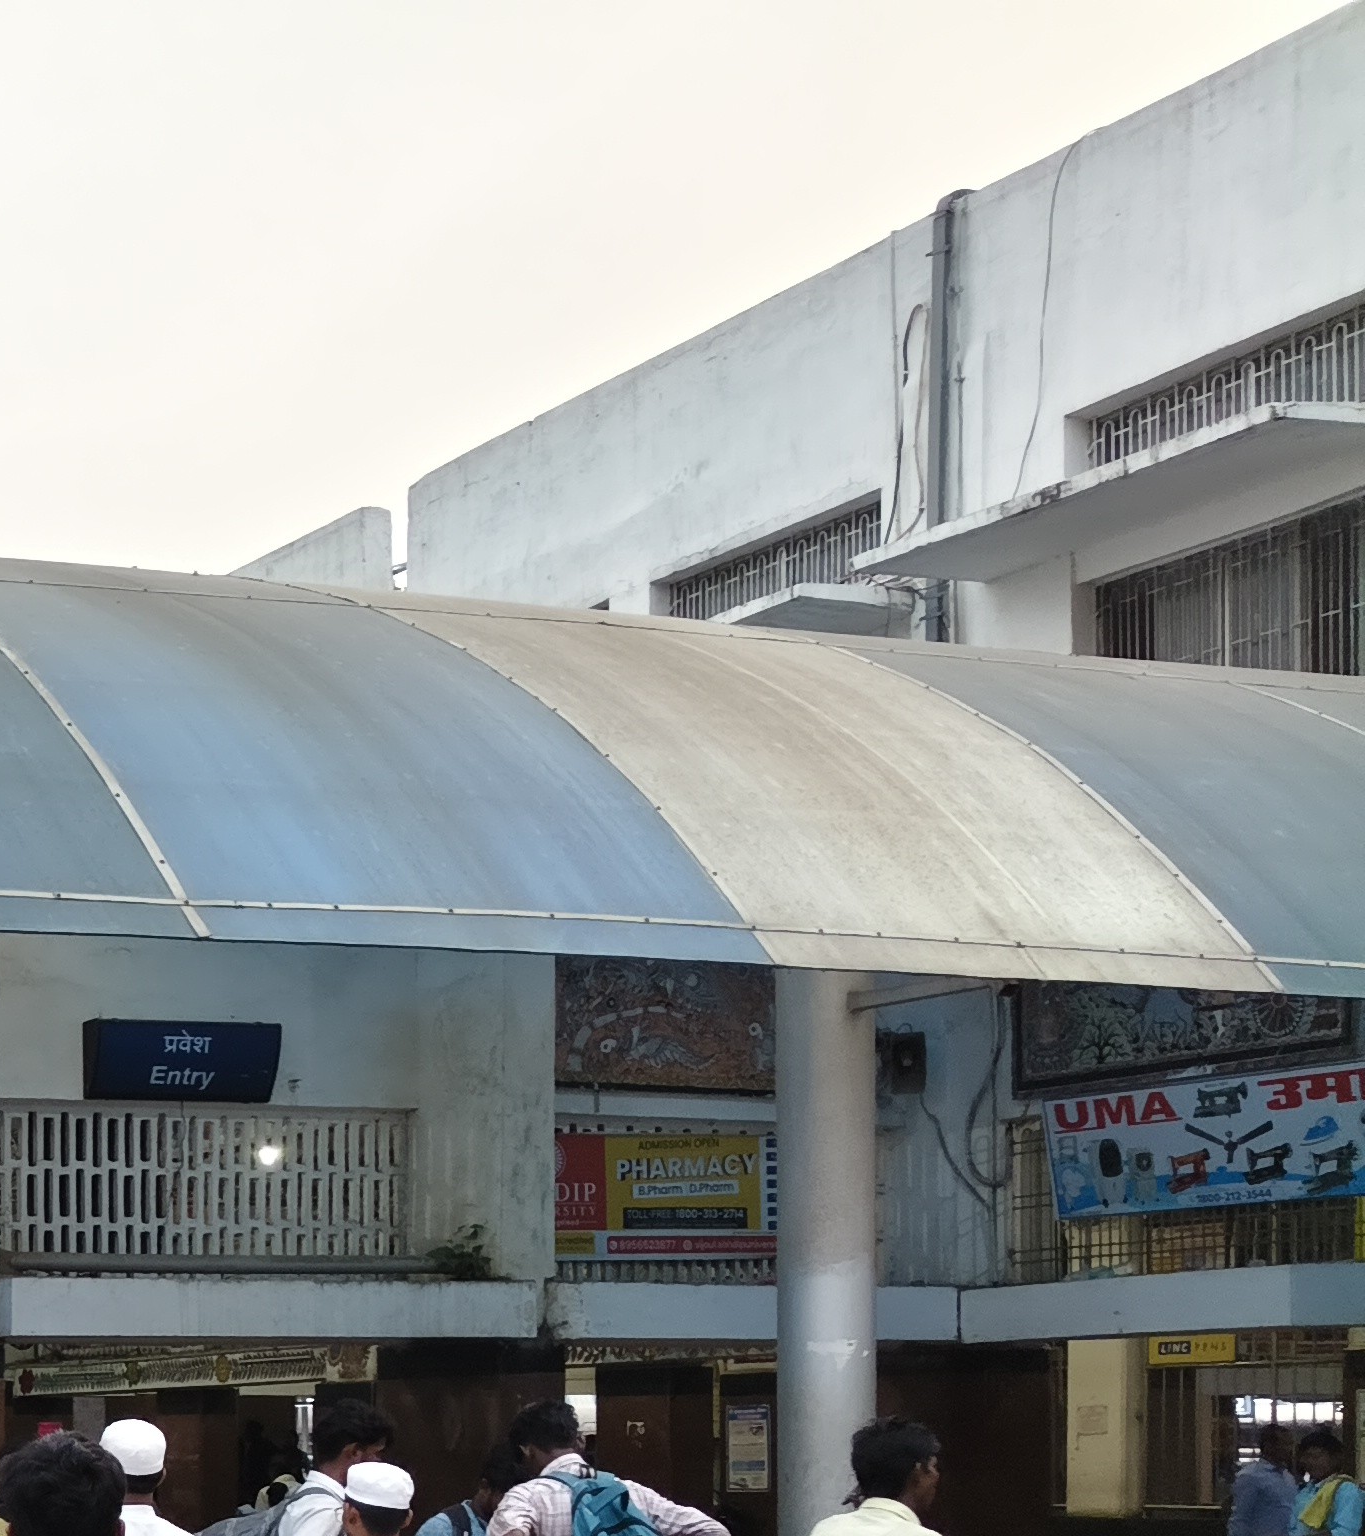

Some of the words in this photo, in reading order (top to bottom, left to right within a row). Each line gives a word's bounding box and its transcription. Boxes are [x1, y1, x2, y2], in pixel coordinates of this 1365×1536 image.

[163, 1029, 212, 1054] प्रवेश
[149, 1065, 215, 1091] Entry
[1054, 1091, 1178, 1131] UMA
[638, 1139, 692, 1150] ADMISSION
[694, 1137, 720, 1148] OPEN
[615, 1152, 758, 1180] PHARMACY
[555, 1183, 597, 1201] DIP
[638, 1185, 684, 1196] B.Pharm
[689, 1183, 735, 1194] D.Pharm
[555, 1206, 596, 1216] RSITY
[1160, 1343, 1188, 1354] LINC
